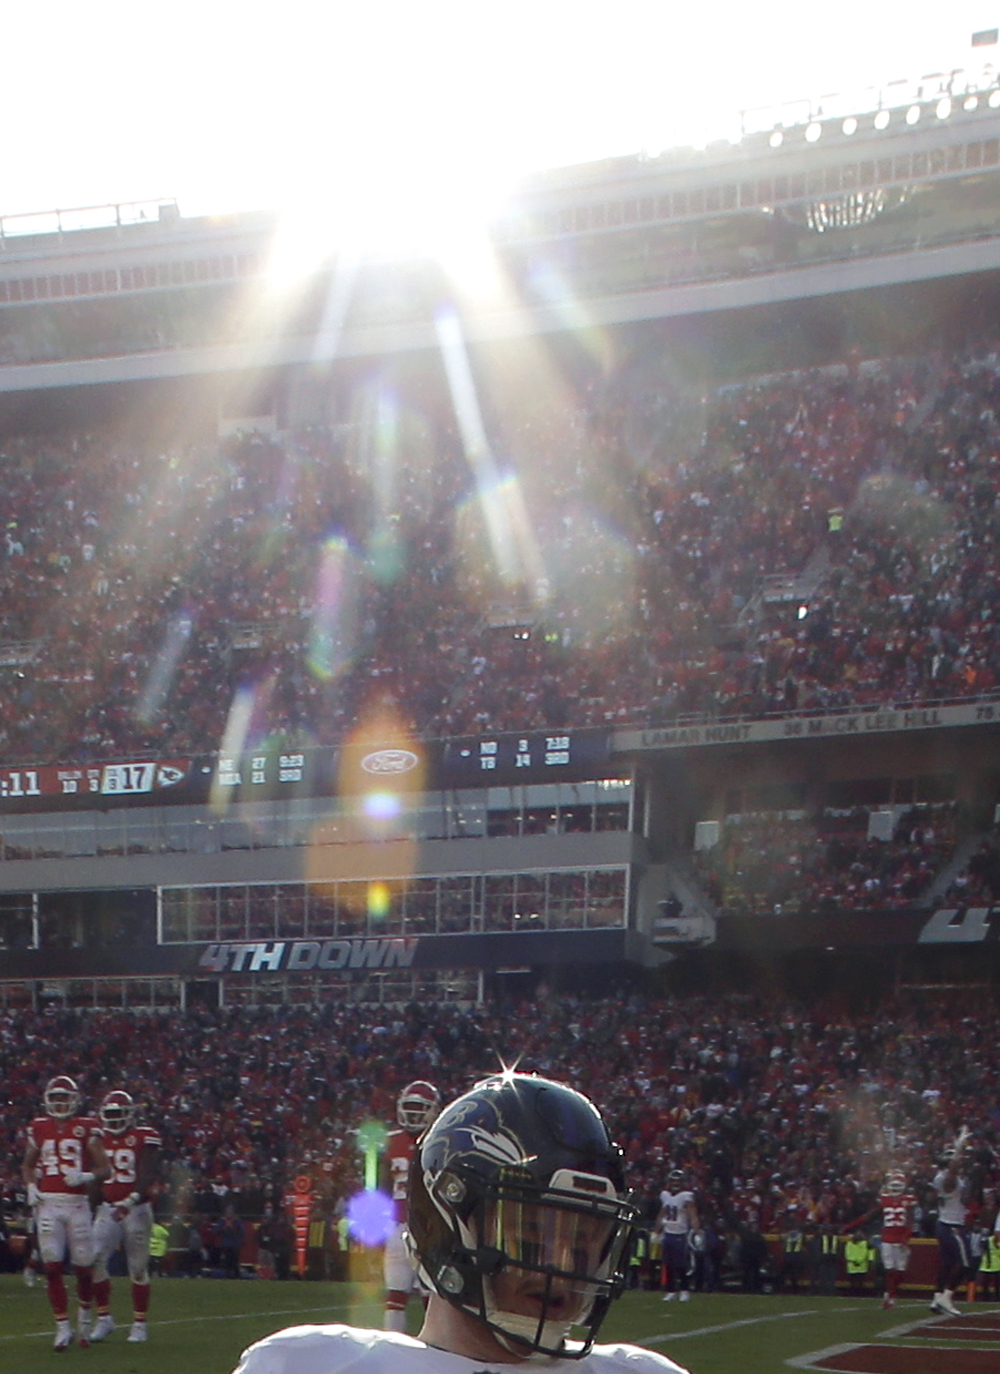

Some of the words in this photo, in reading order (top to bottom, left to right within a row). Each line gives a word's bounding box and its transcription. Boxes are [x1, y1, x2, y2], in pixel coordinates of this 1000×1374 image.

[122, 766, 147, 790] 17
[199, 943, 285, 971] 4TH
[286, 938, 420, 970] DOWN
[41, 1138, 83, 1176] 49
